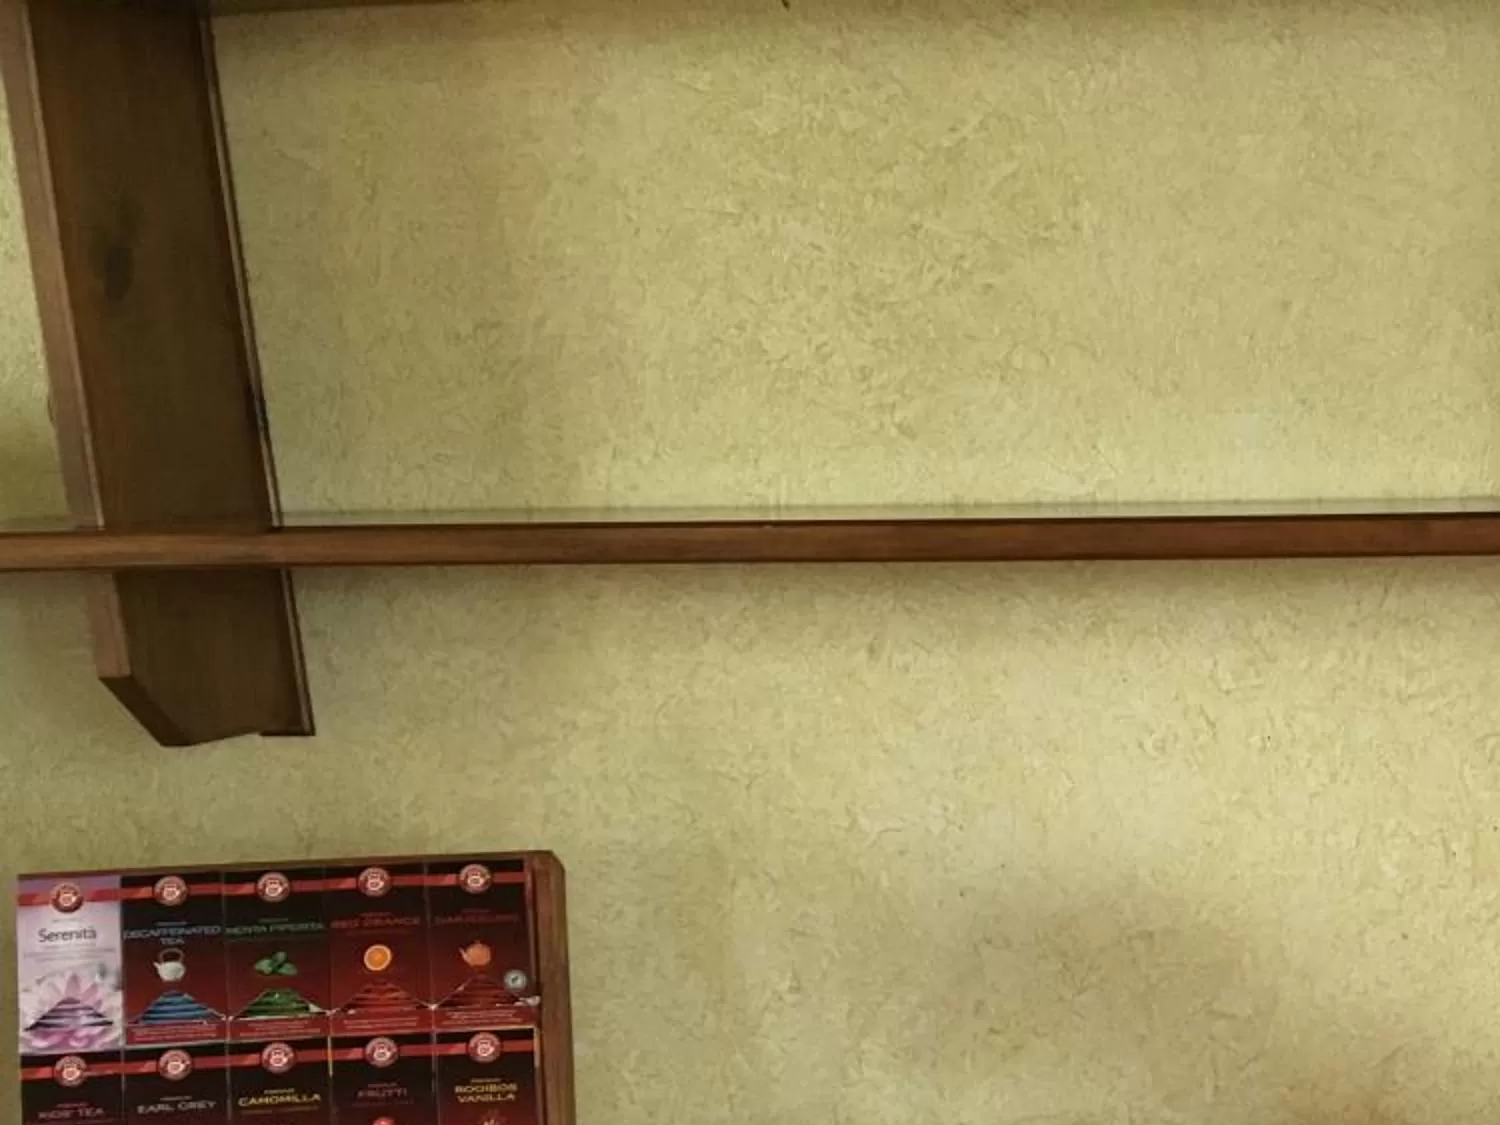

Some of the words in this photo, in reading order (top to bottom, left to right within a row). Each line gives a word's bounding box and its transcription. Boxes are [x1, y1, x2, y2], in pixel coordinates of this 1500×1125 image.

[38, 926, 97, 943] Serenità
[238, 1093, 321, 1108] CAMOMILLA
[136, 1102, 174, 1115] EARL
